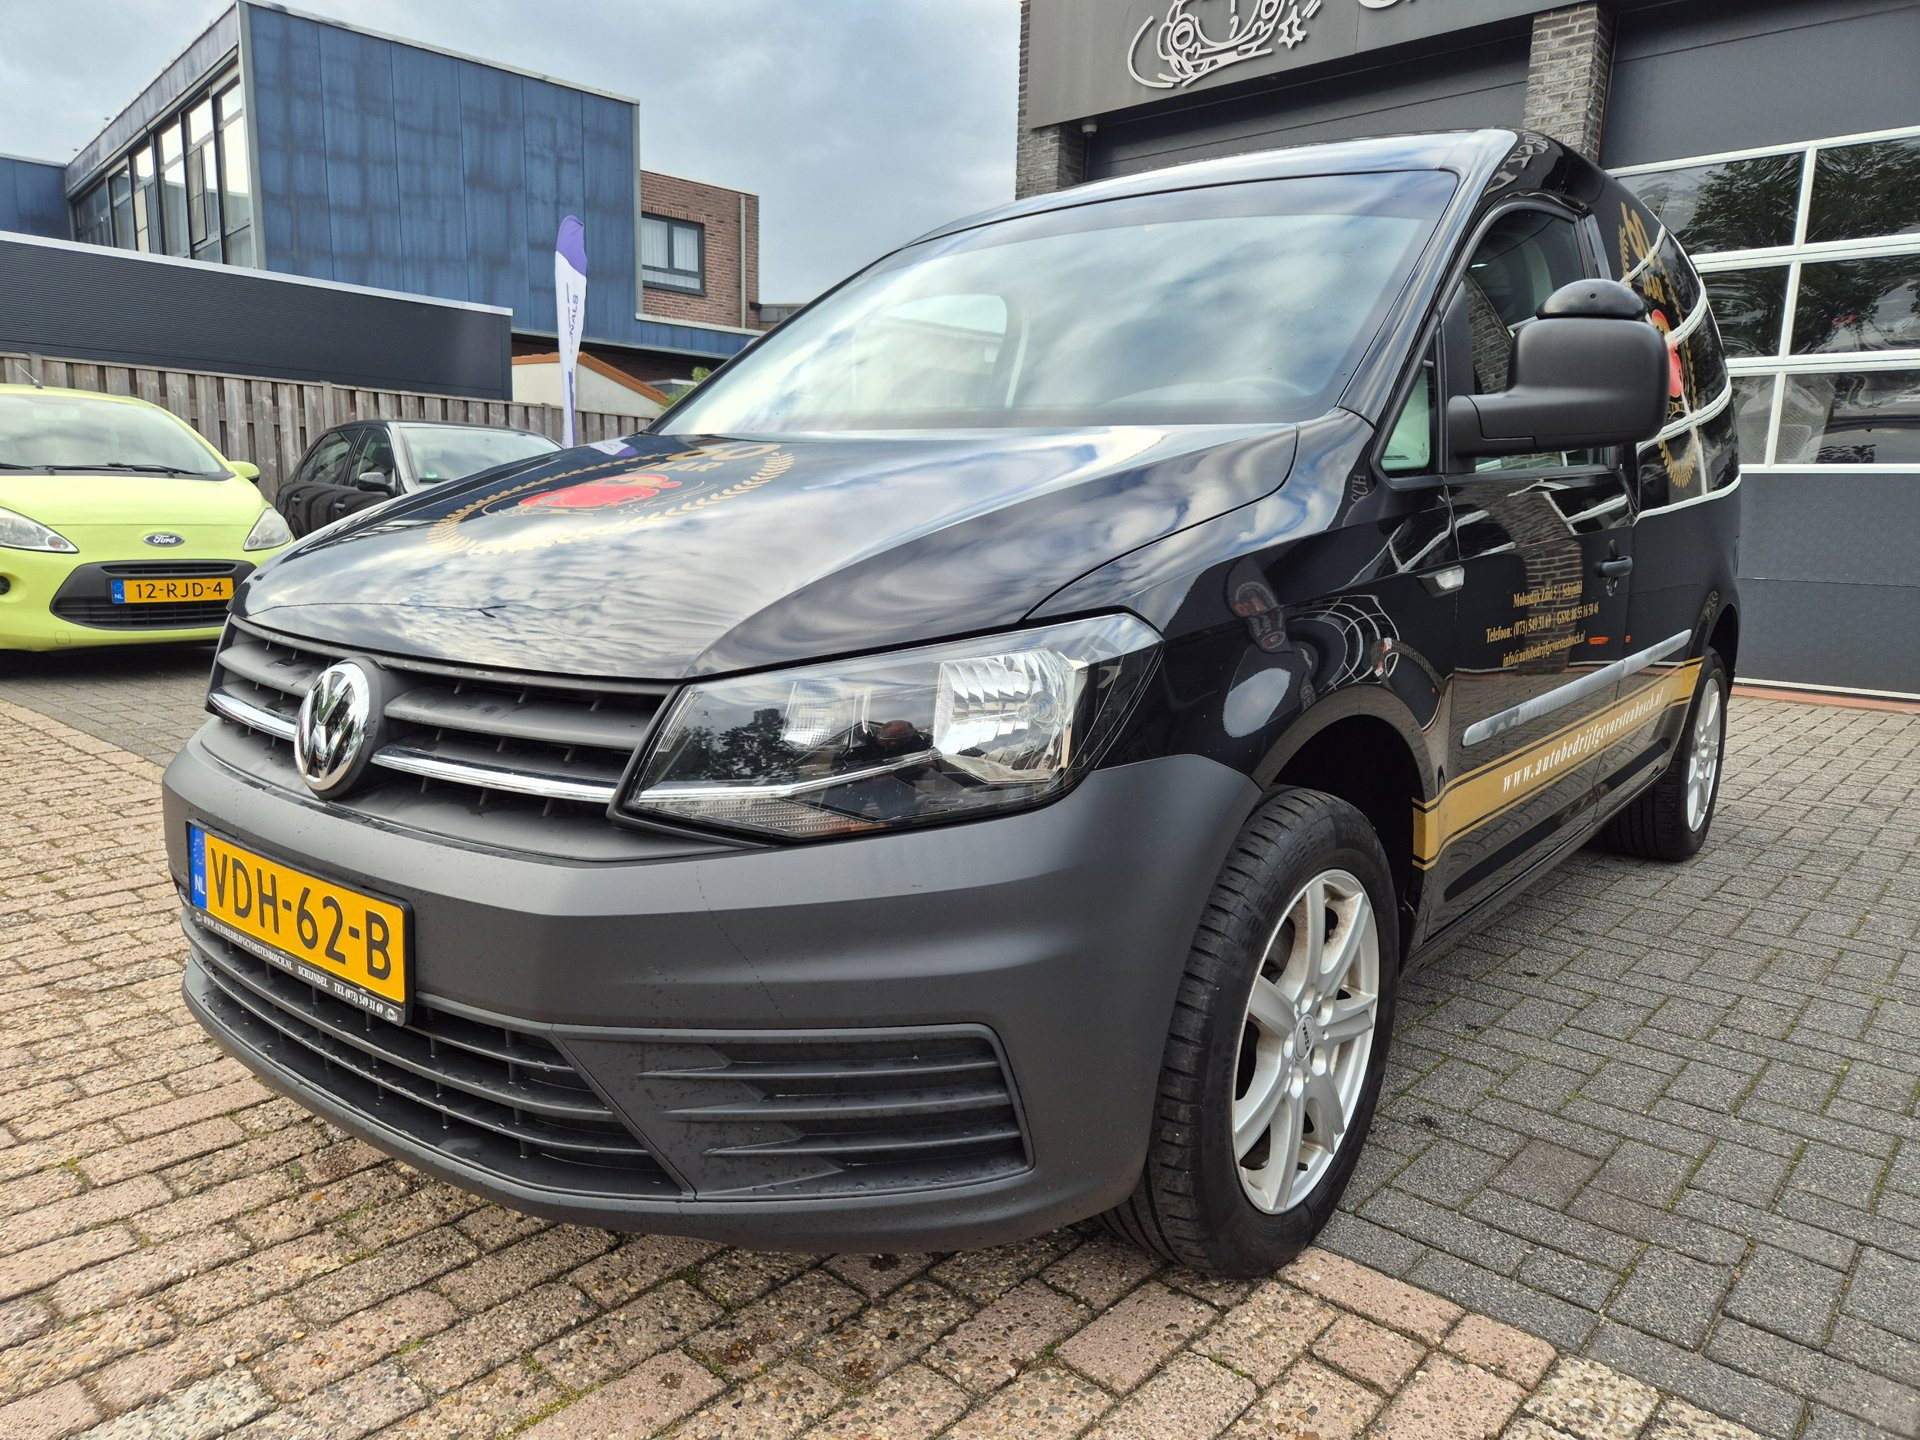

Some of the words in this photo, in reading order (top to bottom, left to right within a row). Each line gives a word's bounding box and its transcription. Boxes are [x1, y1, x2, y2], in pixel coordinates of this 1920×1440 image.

[136, 581, 223, 599] 12-RJD-4
[1486, 625, 1513, 643] Telefoon:
[194, 874, 206, 896] NL
[210, 847, 391, 981] VDH-62-B
[297, 965, 328, 988] SCHIJNDEL
